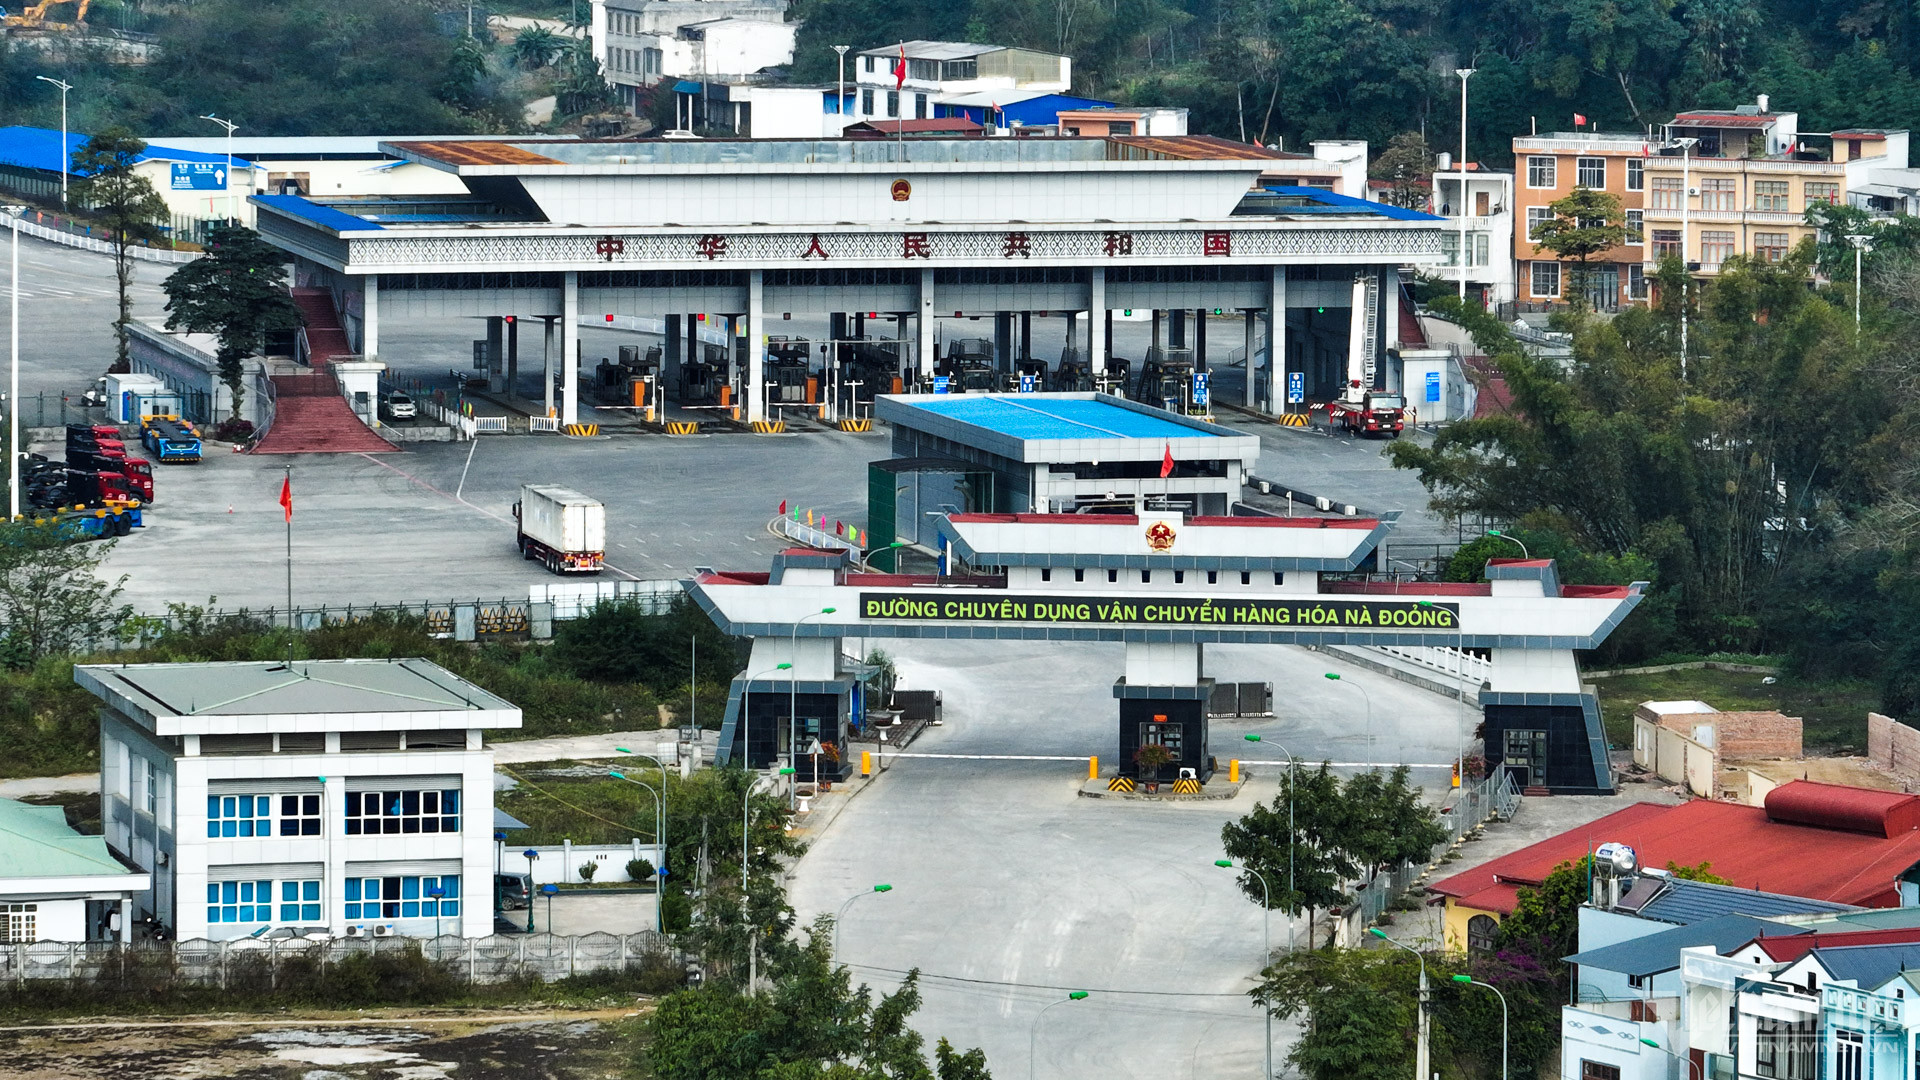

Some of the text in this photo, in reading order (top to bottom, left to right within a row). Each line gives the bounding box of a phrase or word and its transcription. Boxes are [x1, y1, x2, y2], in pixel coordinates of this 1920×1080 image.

[597, 232, 1230, 261] 中华人民共和国
[867, 597, 1451, 626] ĐƯỜNG CHUYÊN DỤNG VẬN CHUYỂN HÀNG HÓA NÀ ĐOỎNG
